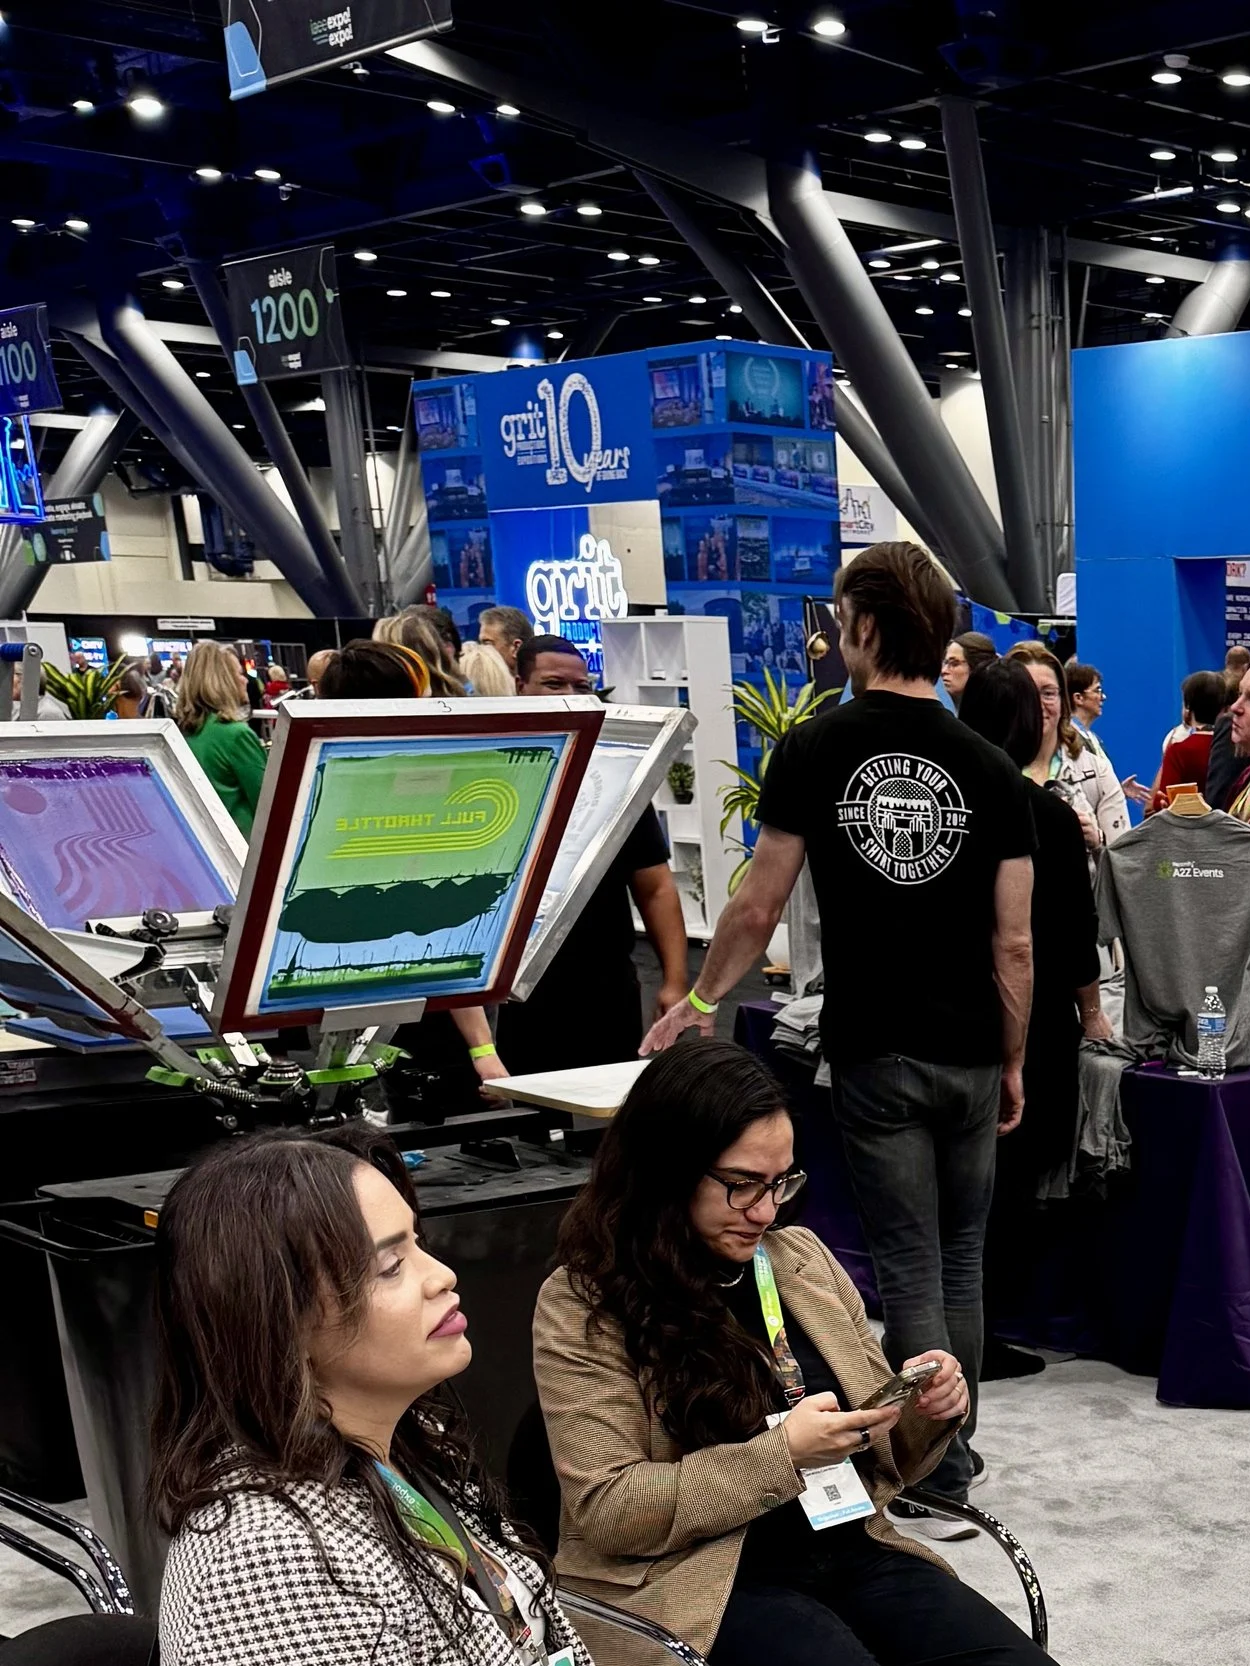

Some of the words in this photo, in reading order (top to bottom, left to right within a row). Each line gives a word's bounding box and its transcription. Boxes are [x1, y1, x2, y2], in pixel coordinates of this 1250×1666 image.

[268, 267, 293, 288] aisle
[250, 288, 319, 344] 1200
[500, 400, 546, 458] grit
[437, 700, 453, 713] 3
[860, 758, 911, 788] GETTING
[915, 762, 948, 794] YOUR
[837, 806, 865, 822] SINCE
[945, 813, 967, 827] 2014
[860, 837, 893, 873] SHIRT
[893, 843, 952, 880] TOGETHER
[1172, 868, 1192, 877] A2Z
[1193, 868, 1224, 878] Events
